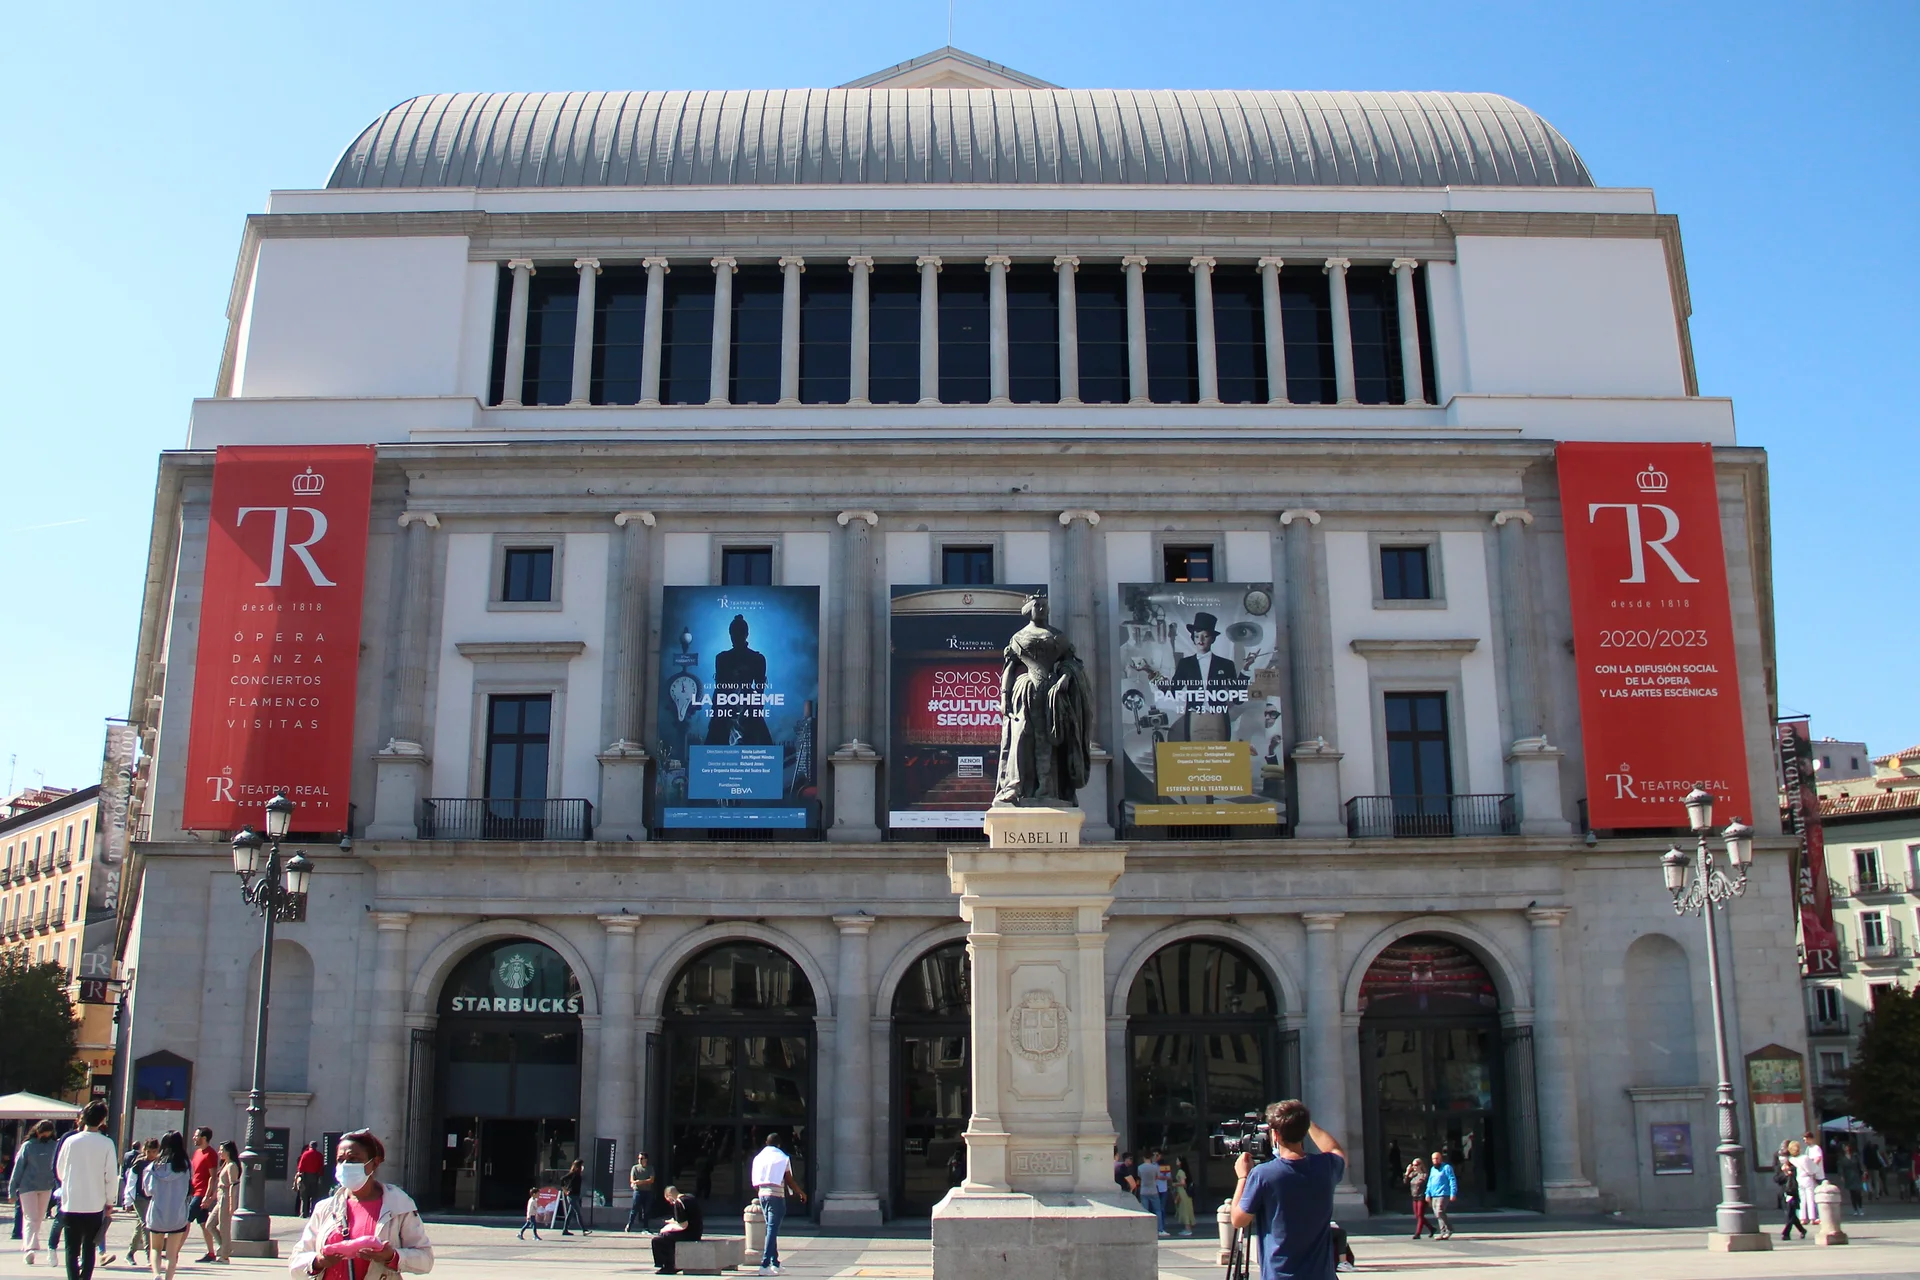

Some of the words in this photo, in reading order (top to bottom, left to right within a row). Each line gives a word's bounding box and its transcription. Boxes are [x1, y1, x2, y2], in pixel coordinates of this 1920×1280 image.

[237, 507, 337, 586] TR
[1589, 503, 1700, 583] TR
[242, 603, 282, 611] desde
[293, 603, 322, 611] 1818
[1611, 600, 1651, 608] desde
[1661, 600, 1689, 608] 1818
[234, 631, 325, 642] ÓPERA
[1600, 629, 1708, 649] 2020/2023
[232, 654, 323, 663] DANZA
[1595, 665, 1617, 674] CON
[1635, 662, 1681, 673] DIFUSIÓN
[1683, 664, 1718, 673] SOCIAL
[230, 676, 321, 685] CONCIERTOS
[935, 671, 991, 684] SOMOS
[994, 671, 1003, 684] Y
[1625, 677, 1639, 685] DE
[1641, 677, 1655, 685] LA
[1657, 675, 1690, 685] ÓPERA
[691, 693, 713, 706] LA
[717, 690, 785, 706] BOHÈME
[1154, 687, 1249, 702] PARTÉNOPE
[1600, 689, 1607, 698] Y
[1609, 689, 1629, 697] LAS
[1631, 688, 1662, 697] ARTES
[1664, 686, 1718, 697] ESCÉNICAS
[228, 697, 320, 707] FLAMENCO
[928, 700, 1001, 712] #CULTUR
[705, 709, 714, 718] 12
[718, 709, 733, 718] DIC
[743, 709, 749, 718] 4
[753, 709, 770, 718] ENE
[1209, 706, 1228, 714] NOV
[227, 719, 318, 729] VISITAS
[937, 713, 1003, 726] SEGURA
[1188, 774, 1222, 782] endesa
[206, 777, 235, 802] TR
[240, 785, 290, 795] TEATRO
[296, 786, 329, 795] REAL
[1605, 774, 1638, 799] TR
[1640, 781, 1690, 791] TEATRO
[1784, 757, 1808, 853] MPORADA
[1004, 831, 1053, 844] ISABEL
[1059, 831, 1068, 844] II
[452, 997, 579, 1013] STARBUCKS
